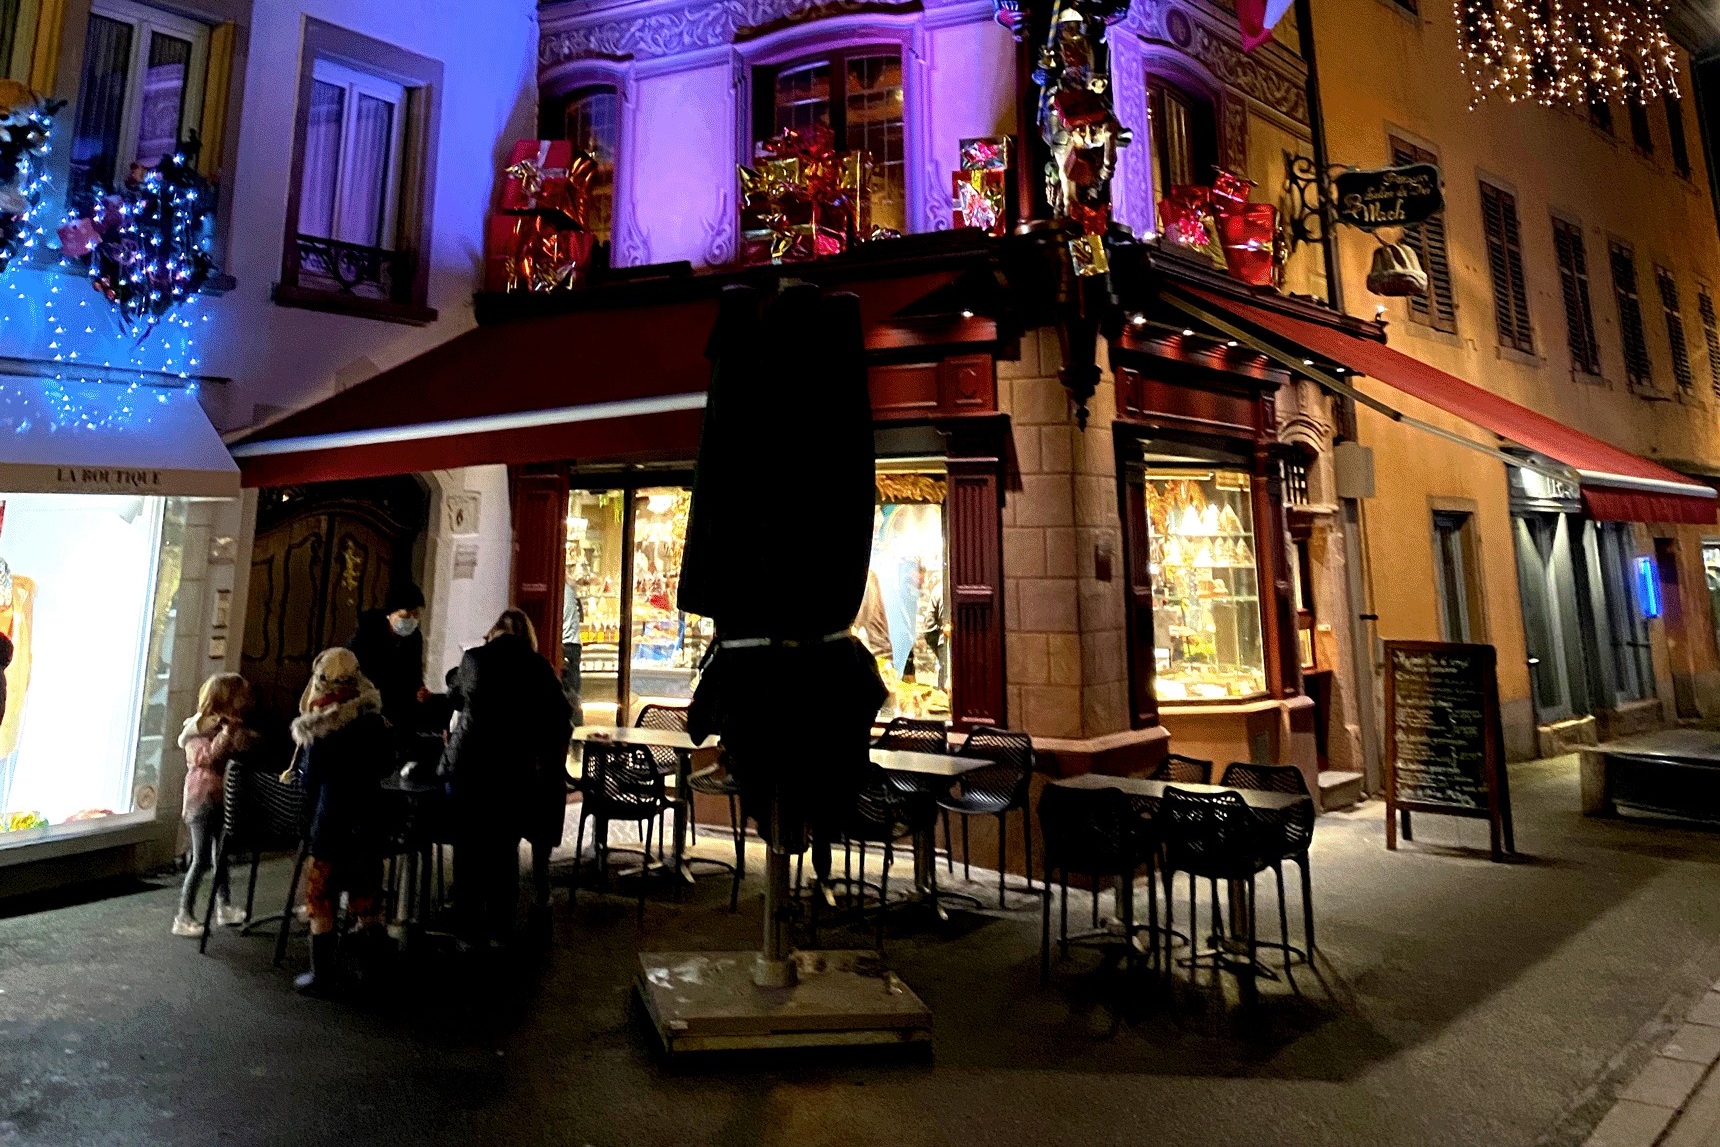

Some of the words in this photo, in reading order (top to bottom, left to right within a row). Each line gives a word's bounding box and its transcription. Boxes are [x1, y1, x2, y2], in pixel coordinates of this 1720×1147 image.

[57, 468, 77, 483] LA
[82, 469, 162, 487] BOUTIQUE
[456, 508, 464, 526] 6
